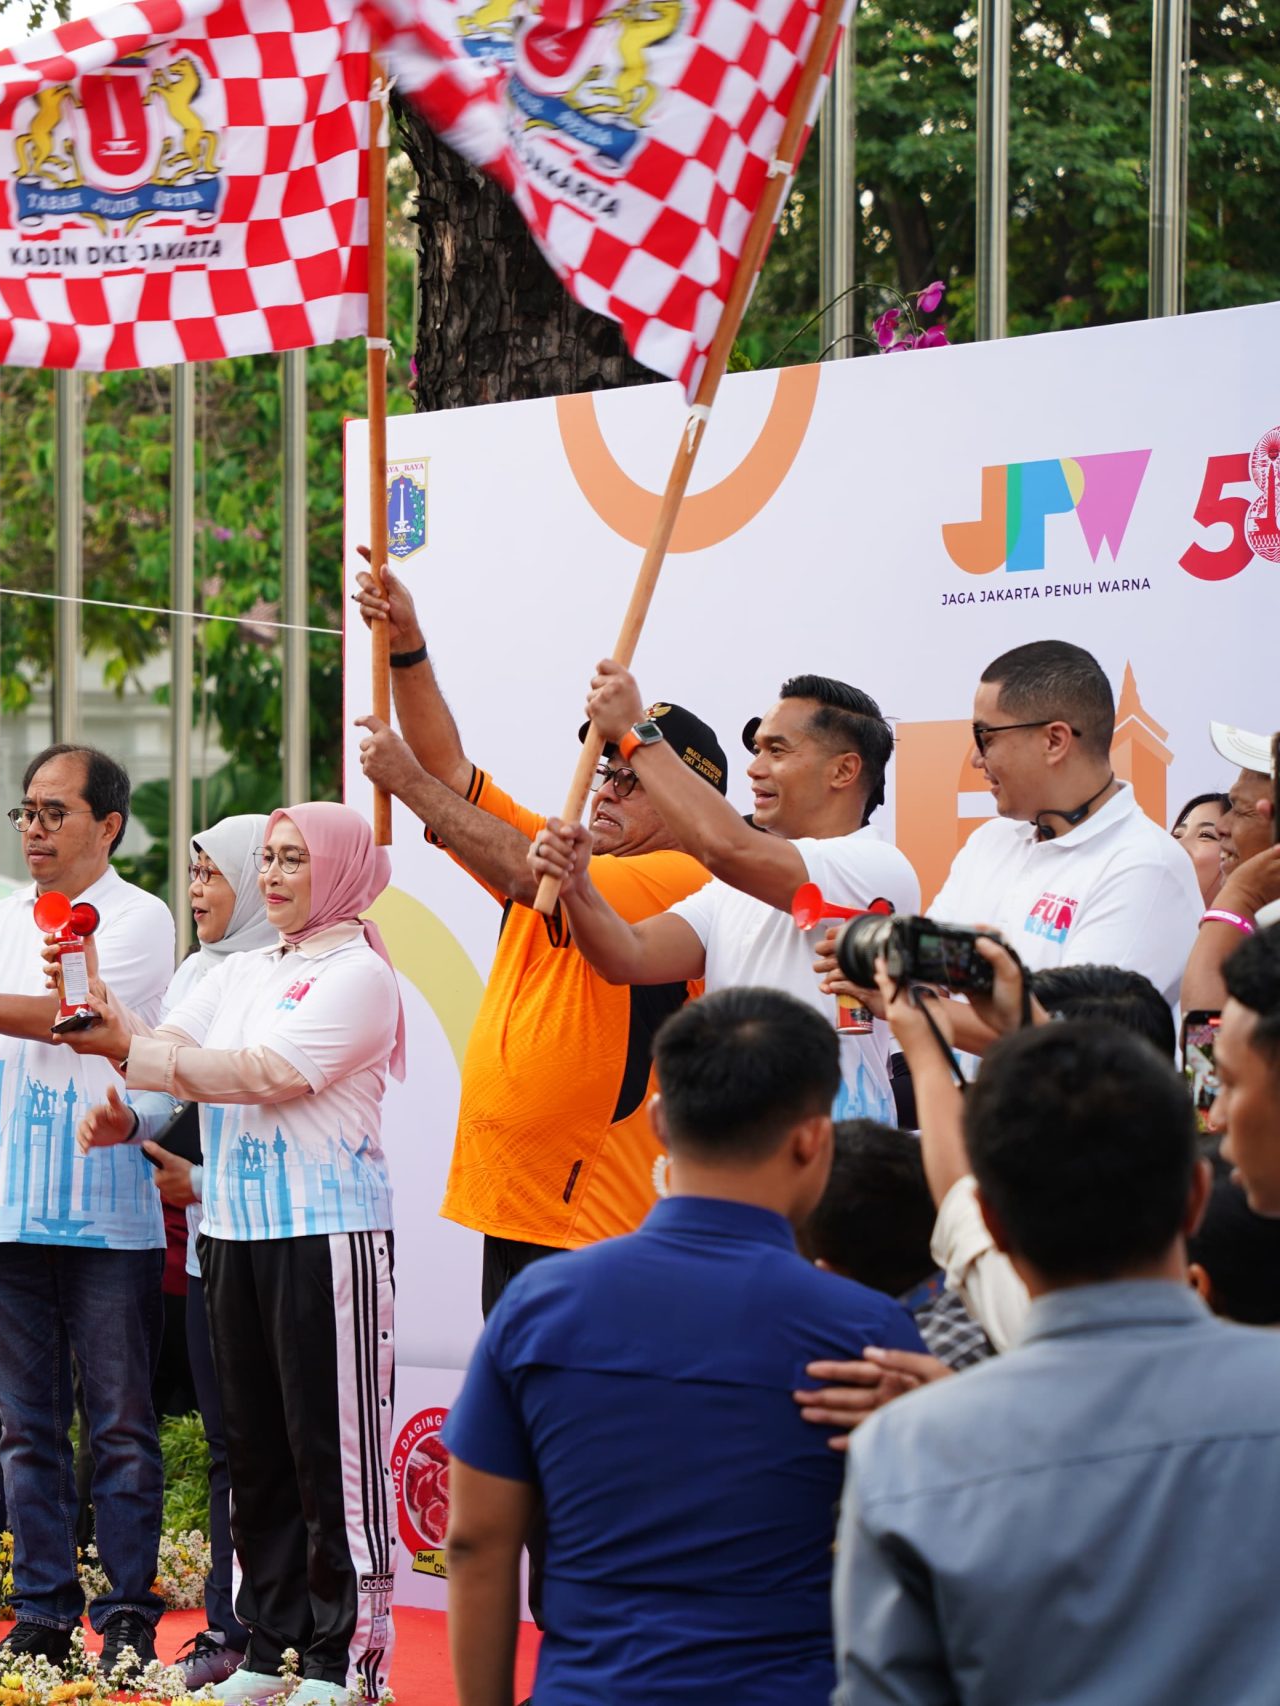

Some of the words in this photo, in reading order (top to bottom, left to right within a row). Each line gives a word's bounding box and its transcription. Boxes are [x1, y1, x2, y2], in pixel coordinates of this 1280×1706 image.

[9, 246, 78, 266] KADIN
[87, 244, 128, 265] DKI
[138, 239, 223, 261] JAKARTA
[941, 592, 976, 606] JAGA
[980, 586, 1040, 603] JAKARTA
[1045, 582, 1092, 597] PENUH
[1098, 577, 1151, 594] WARNA
[393, 1455, 404, 1502] OKO
[401, 1414, 443, 1451] DAGING
[417, 1552, 435, 1564] Beef
[361, 1577, 393, 1590] adidas
